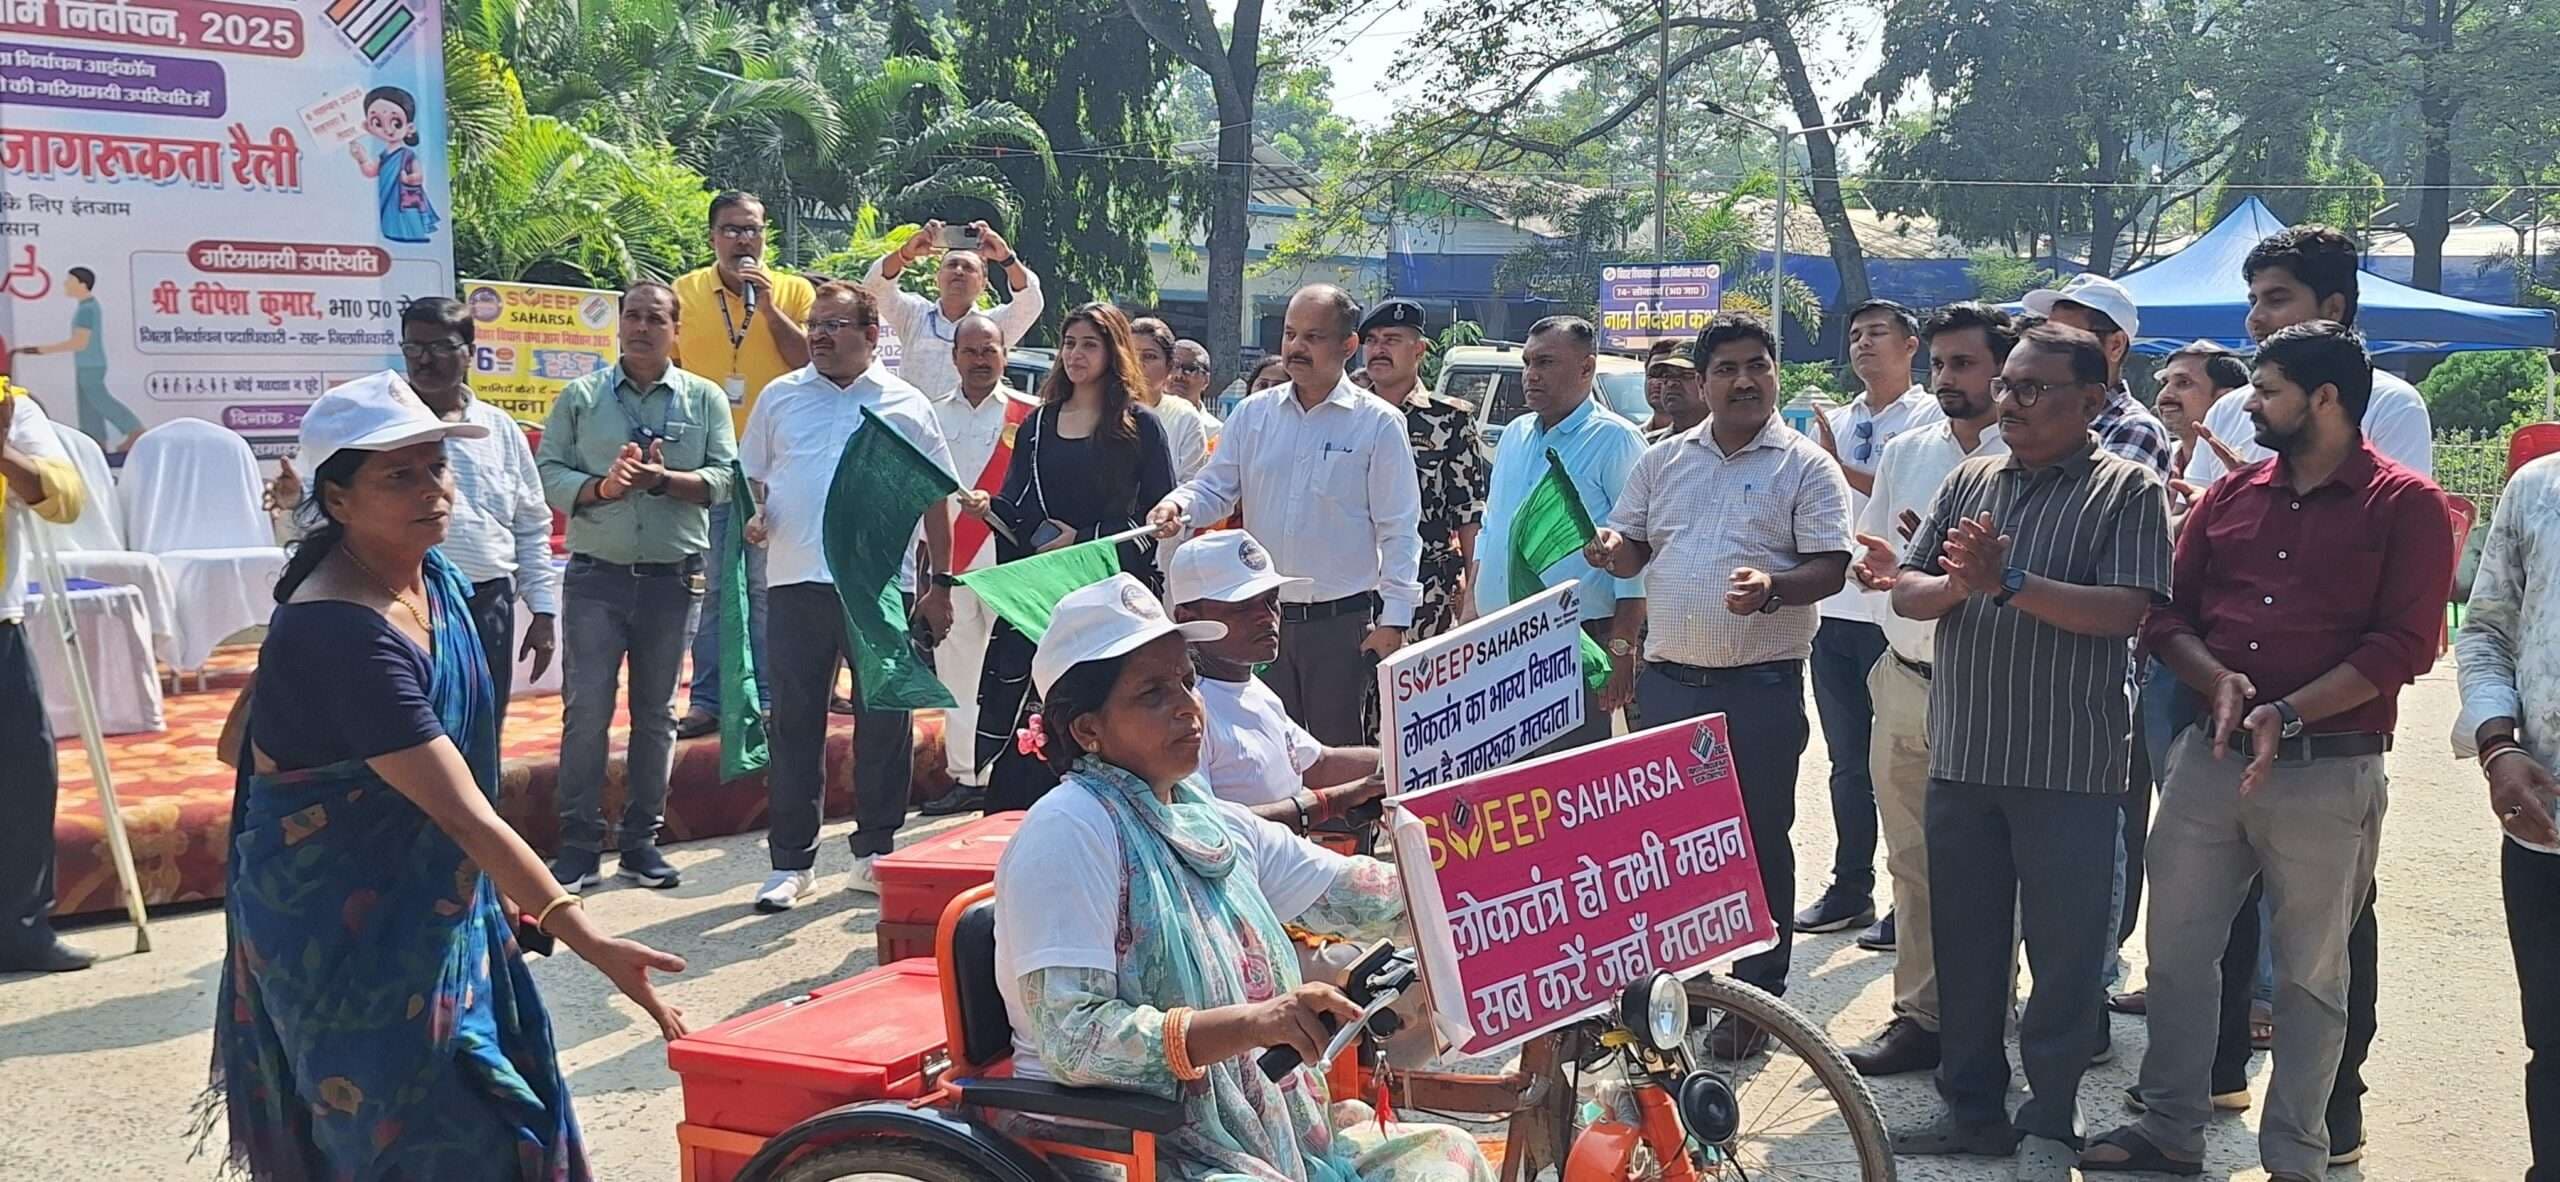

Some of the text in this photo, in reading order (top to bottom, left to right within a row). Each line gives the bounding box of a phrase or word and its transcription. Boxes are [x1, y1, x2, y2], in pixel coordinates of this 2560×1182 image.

[200, 12, 295, 50] 2025
[14, 49, 83, 71] निर्वाचन
[9, 77, 35, 95] की
[36, 79, 122, 101] गरिमामयी
[123, 87, 194, 106] उपस्थिति
[0, 122, 302, 193] जागरूकता रैली
[28, 193, 63, 215] लिए
[70, 195, 131, 216] इंतजाम
[0, 222, 40, 237] सान
[200, 244, 380, 273] गरिमामयी उपस्थिति
[152, 280, 181, 315] श्री
[188, 281, 250, 315] दीपेश
[257, 290, 324, 326] कुमार,
[506, 290, 580, 311] SWEEP
[511, 311, 575, 327] SAHARSA
[1604, 310, 1633, 331] नाम
[1635, 301, 1686, 331] निर्देशन
[140, 326, 172, 343] जिला
[174, 326, 222, 343] निर्वाचन
[224, 327, 286, 344] पदाधिकारी
[328, 328, 395, 345] जिलाधिकारी
[229, 408, 285, 426] दिनांक
[479, 399, 545, 414] पना
[1398, 611, 1550, 702] SWEEP SAHARSA
[1403, 645, 1577, 759] लोकतंत्र का भाग्य विधाता,
[1456, 725, 1516, 780] जागरूक
[1519, 695, 1570, 747] मतदाता
[1421, 756, 1685, 871] SWEEP SAHARSA
[1448, 815, 1747, 960] लोकतंत्र हो तभी महान
[1471, 889, 1754, 1038] सब करें जहाँ मतदान
